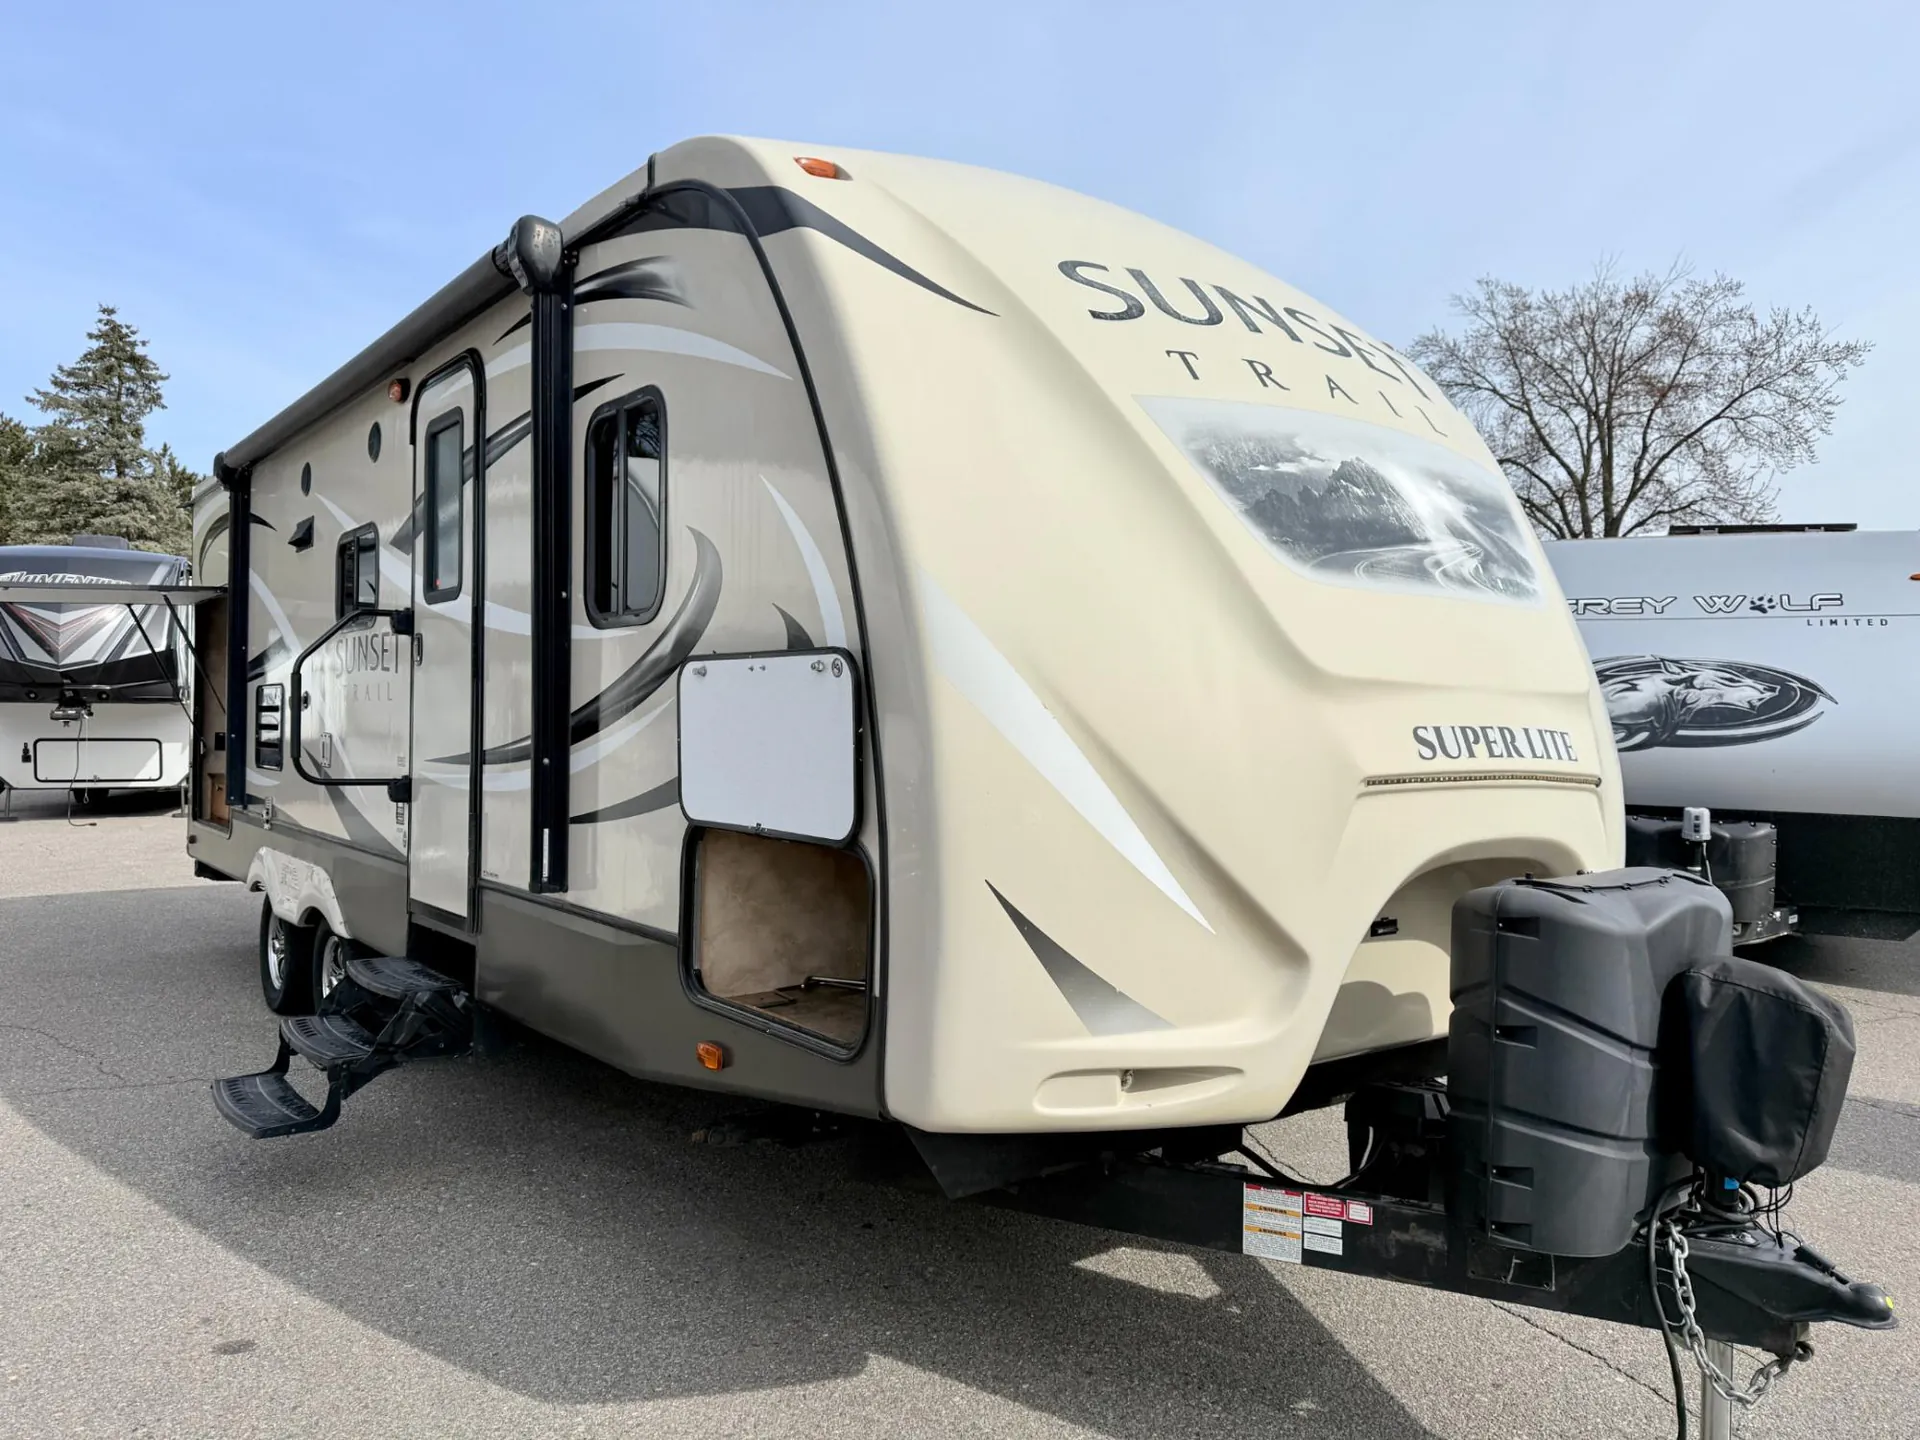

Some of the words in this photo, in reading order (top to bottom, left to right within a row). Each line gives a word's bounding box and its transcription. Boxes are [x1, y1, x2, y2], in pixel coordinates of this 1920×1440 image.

[1057, 260, 1434, 404] SUNSET
[1166, 349, 1448, 437] TRAIL
[336, 632, 399, 678] SUNSET
[1807, 618, 1888, 627] LIMITED
